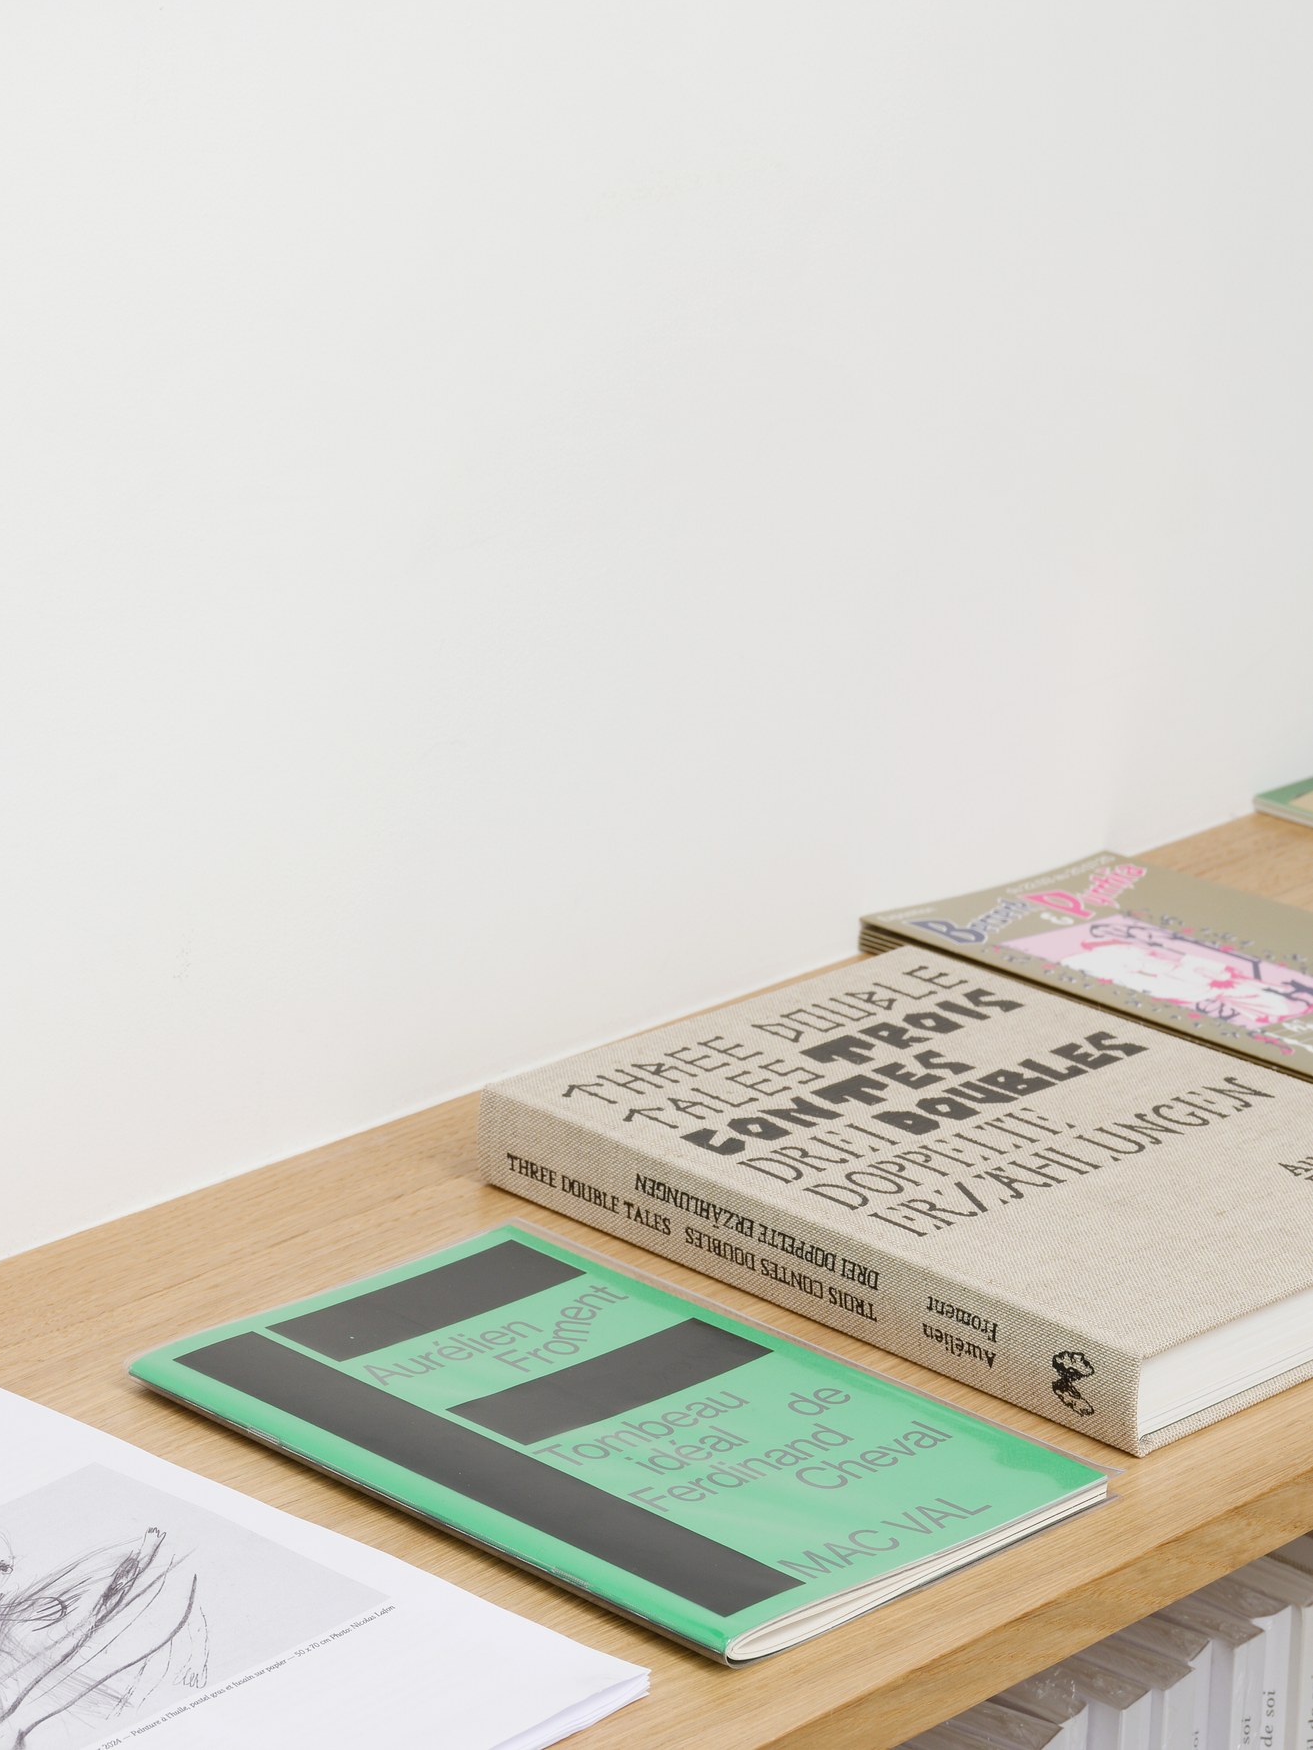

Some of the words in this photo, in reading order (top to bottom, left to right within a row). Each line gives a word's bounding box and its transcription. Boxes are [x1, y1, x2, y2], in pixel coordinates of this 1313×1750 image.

[562, 1036, 763, 1104] THREE
[751, 965, 968, 1043] DOUBLE
[623, 1059, 825, 1129] TALES
[799, 988, 1025, 1064] TROIS
[679, 1050, 976, 1155] CONTES
[737, 1124, 901, 1184] DREI
[872, 1031, 1149, 1135] DOUBLES
[507, 1152, 557, 1188] THREE
[561, 1175, 619, 1214] DOUBLE
[623, 1200, 671, 1235] TALES
[803, 1107, 1076, 1211] DOPPELTE
[685, 1227, 755, 1271] DOUBLES
[758, 1224, 837, 1272] DOPPELTE
[761, 1259, 823, 1299] CONTES
[841, 1258, 879, 1290] DREI
[491, 1284, 630, 1373] Froment
[829, 1286, 877, 1322] TROIS
[927, 1296, 998, 1343] Froment
[362, 1320, 544, 1386] Aurélien
[922, 1322, 996, 1369] Aurélien
[531, 1390, 750, 1467] Tombeau
[624, 1425, 751, 1475] idéal
[787, 1387, 851, 1416] de
[795, 1420, 953, 1490] Cheval
[627, 1422, 855, 1513] Ferdinand
[776, 1528, 900, 1580] MAC
[880, 1496, 993, 1536] VAL
[130, 1720, 161, 1737] Peinture
[190, 1694, 210, 1709] pastel
[254, 1669, 266, 1677] sur
[265, 1659, 287, 1673] papier
[294, 1648, 305, 1658] 50
[309, 1642, 320, 1650] 70
[319, 1637, 331, 1646] cm
[349, 1613, 376, 1630] Nicolas
[1263, 1690, 1276, 1718] soi
[1260, 1725, 1274, 1748] de
